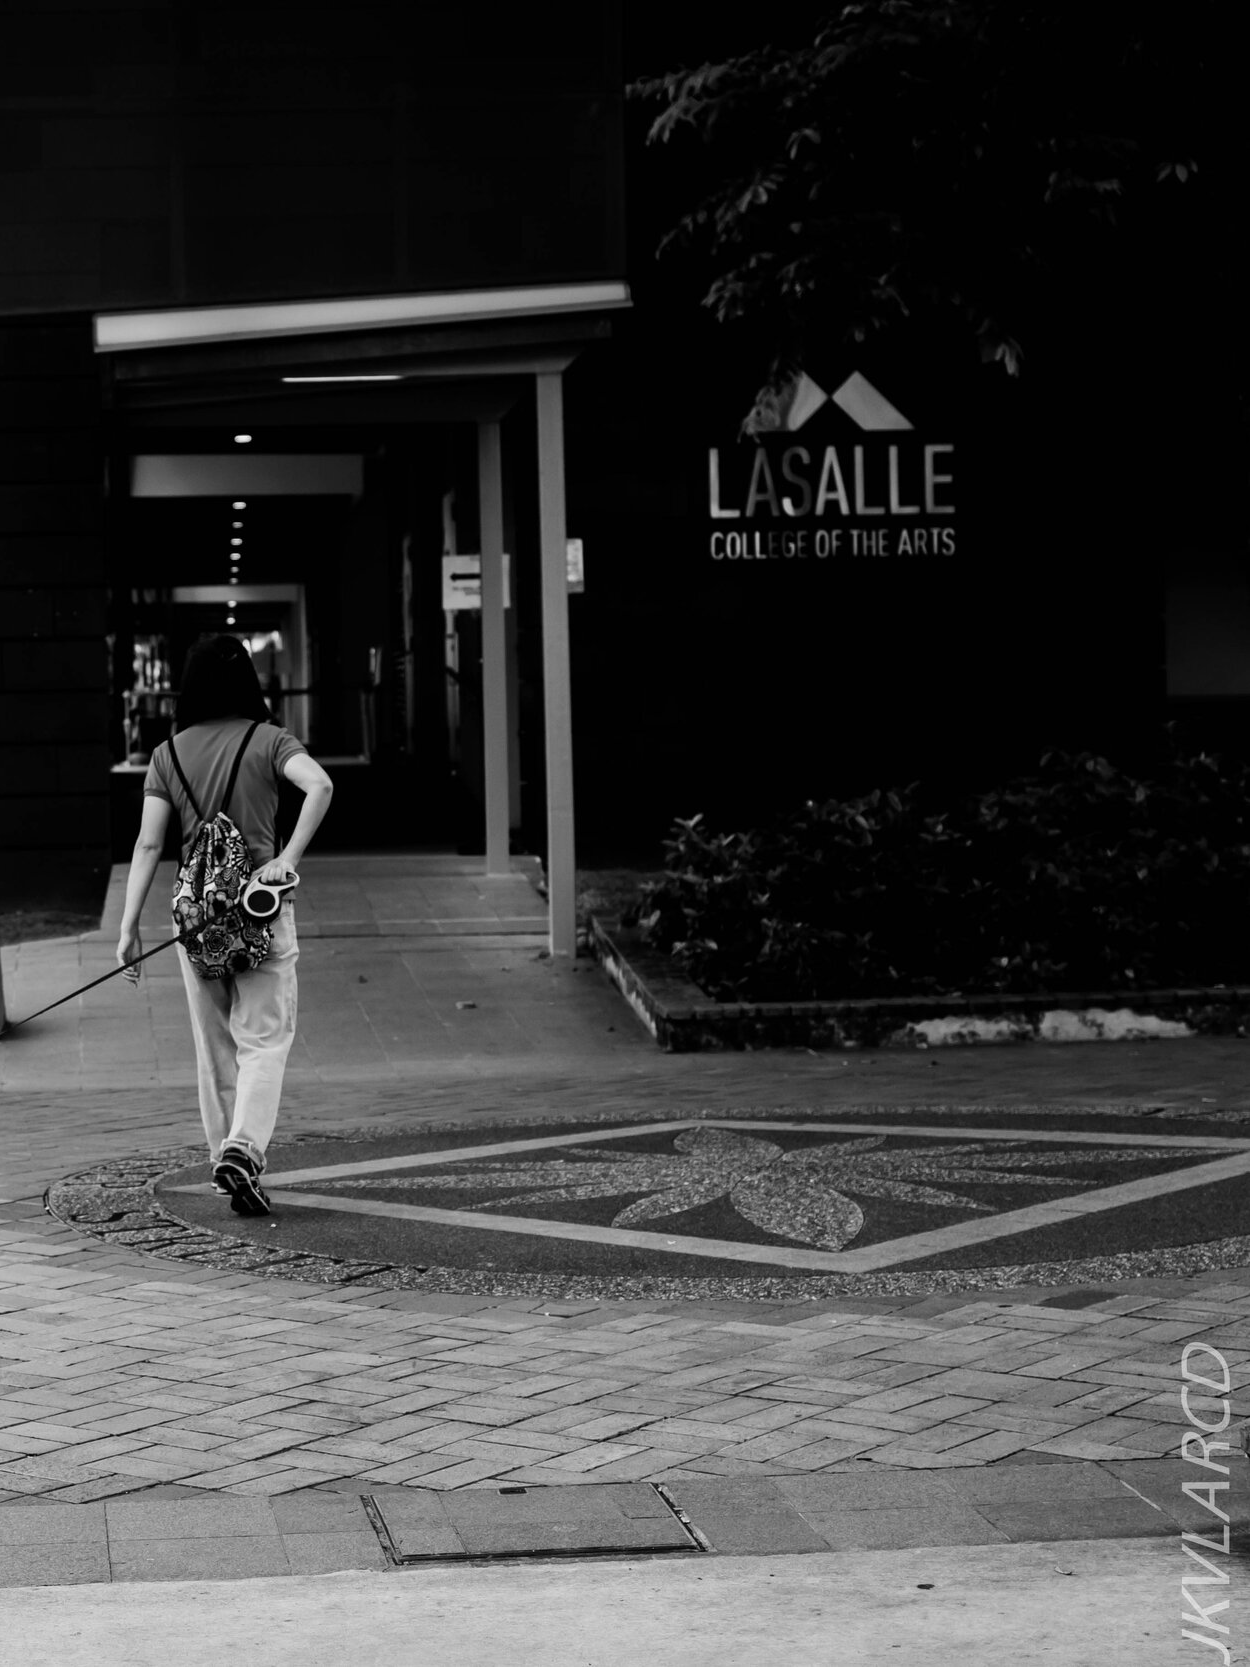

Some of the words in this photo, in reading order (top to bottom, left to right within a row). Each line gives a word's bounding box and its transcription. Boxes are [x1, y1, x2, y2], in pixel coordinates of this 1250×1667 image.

[709, 444, 956, 519] LASALLE
[710, 530, 809, 561] COLLEGE
[814, 528, 843, 559] OF
[849, 528, 890, 557] THE
[898, 526, 956, 557] ARTS
